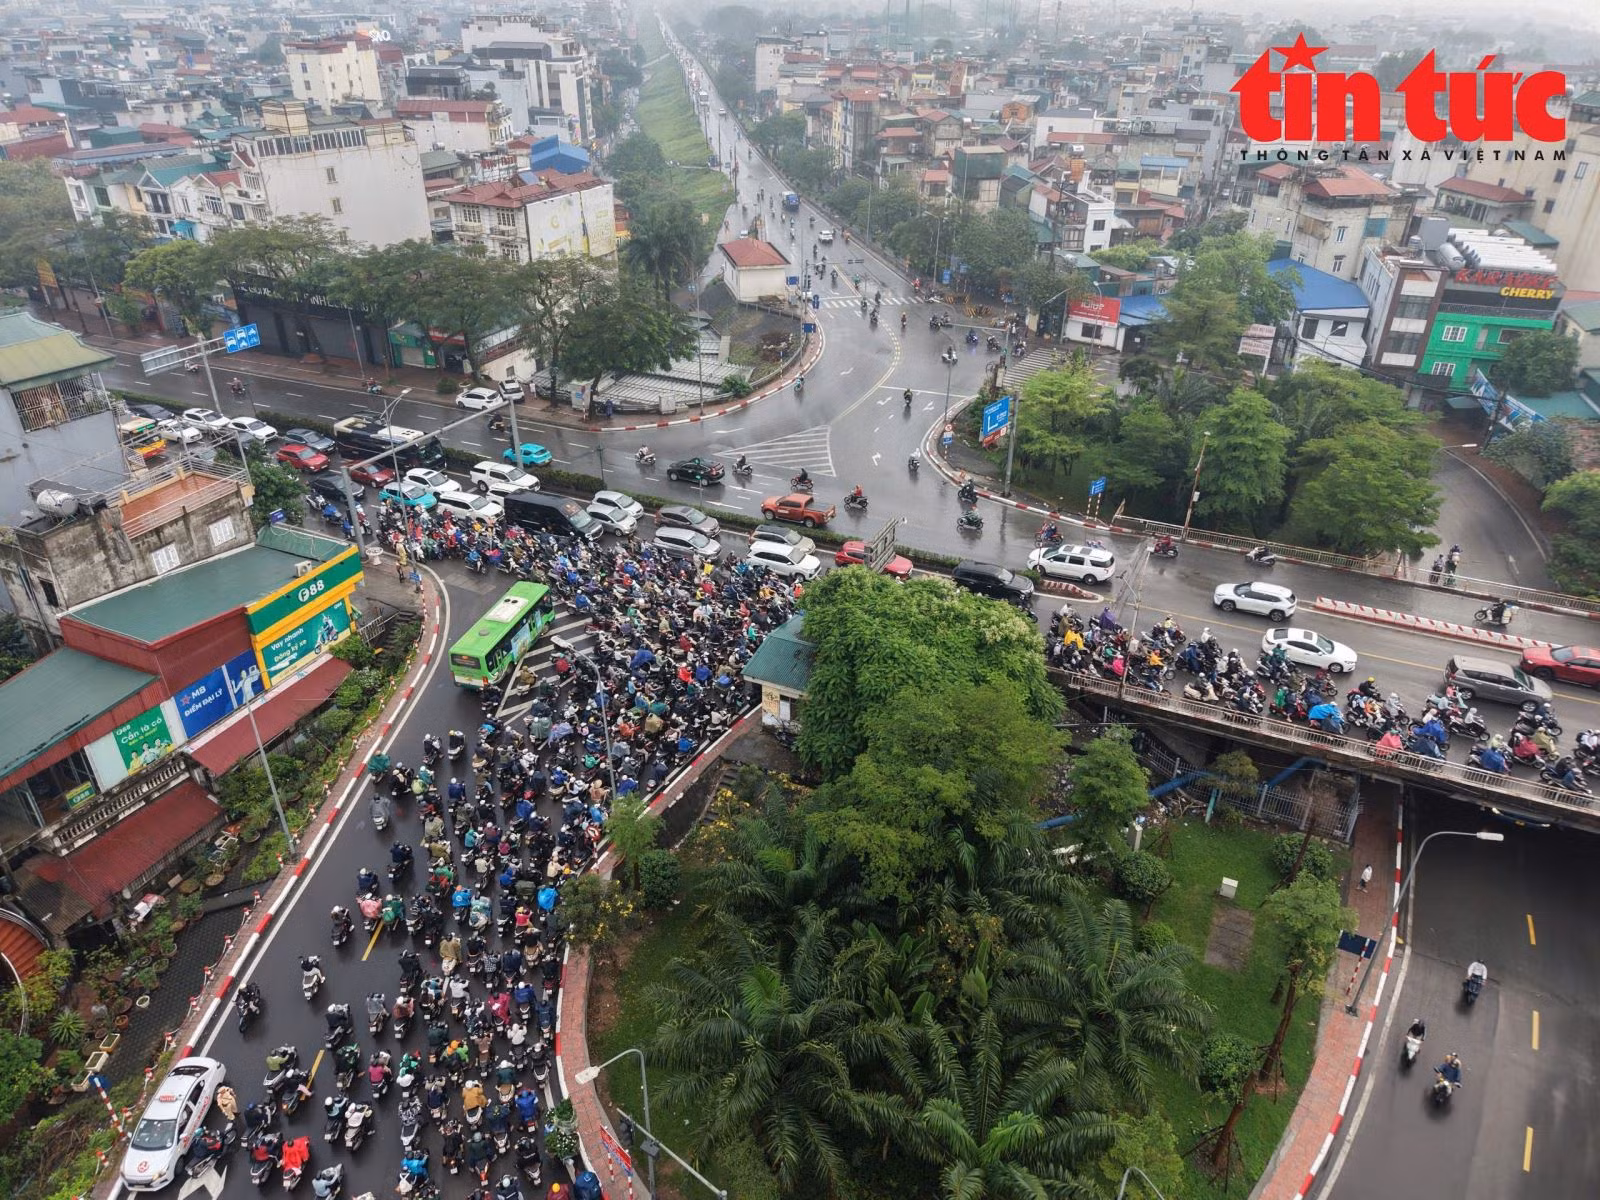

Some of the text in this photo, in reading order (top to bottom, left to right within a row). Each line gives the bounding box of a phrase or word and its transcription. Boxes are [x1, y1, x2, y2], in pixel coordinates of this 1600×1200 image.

[1500, 286, 1555, 300] CHERRY
[298, 579, 325, 602] F88
[271, 628, 304, 651] Vay nhanh
[191, 685, 207, 699] MB
[121, 731, 140, 744] Cần
[141, 724, 150, 734] là
[151, 716, 163, 727] có
